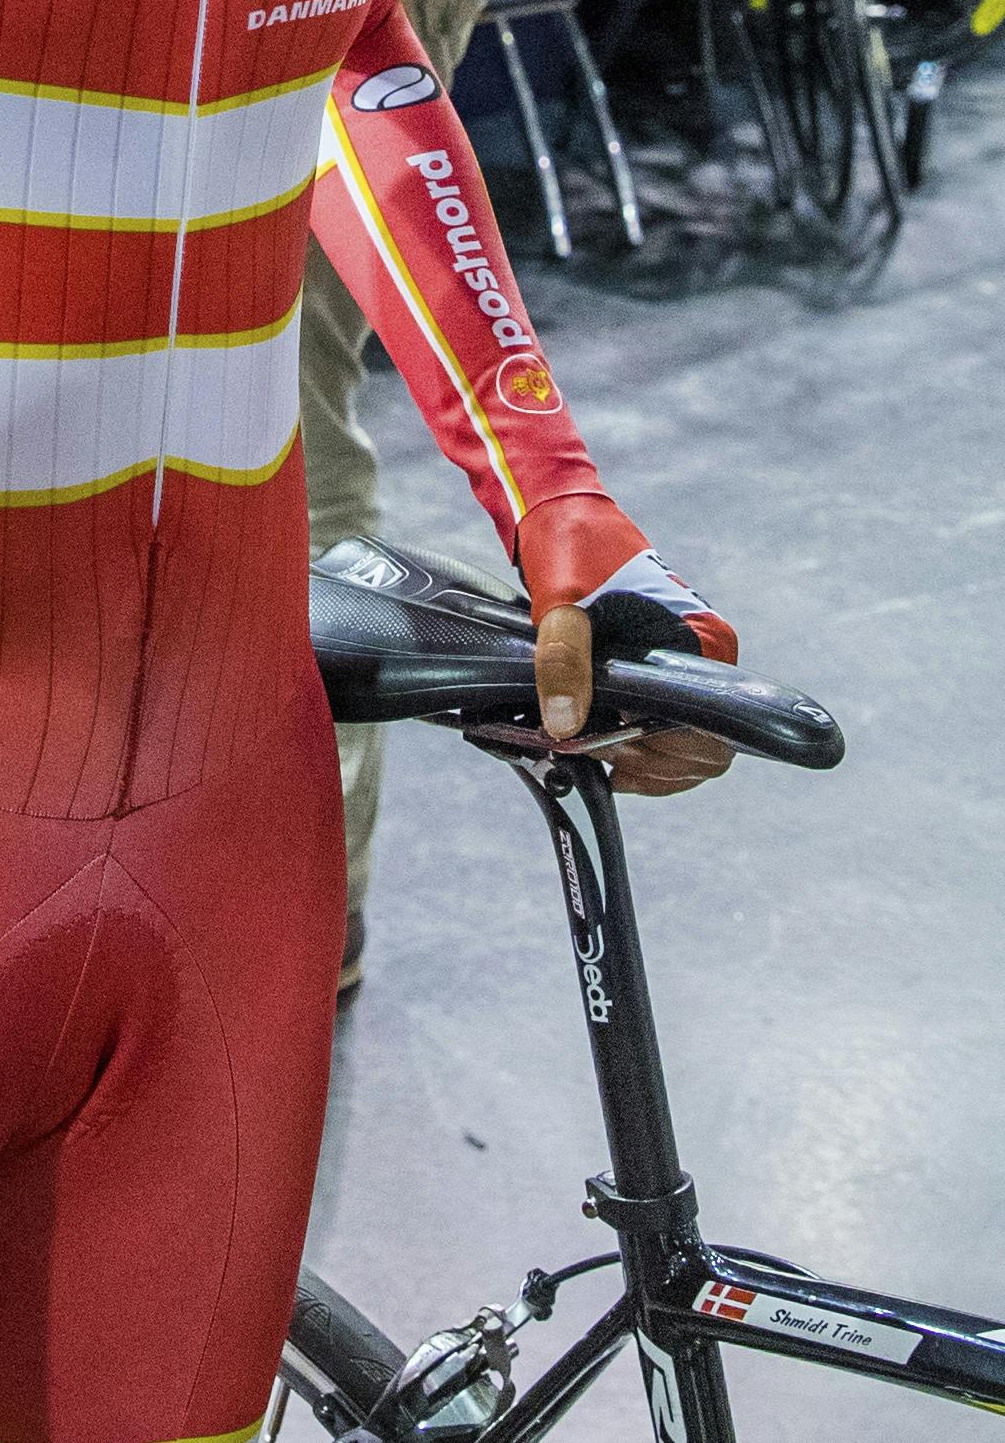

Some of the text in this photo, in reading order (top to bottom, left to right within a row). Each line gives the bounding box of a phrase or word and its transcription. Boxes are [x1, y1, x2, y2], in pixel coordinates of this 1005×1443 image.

[405, 149, 533, 349] postnord
[573, 923, 614, 1024] Deda
[769, 1308, 874, 1347] Shmidt Trine
